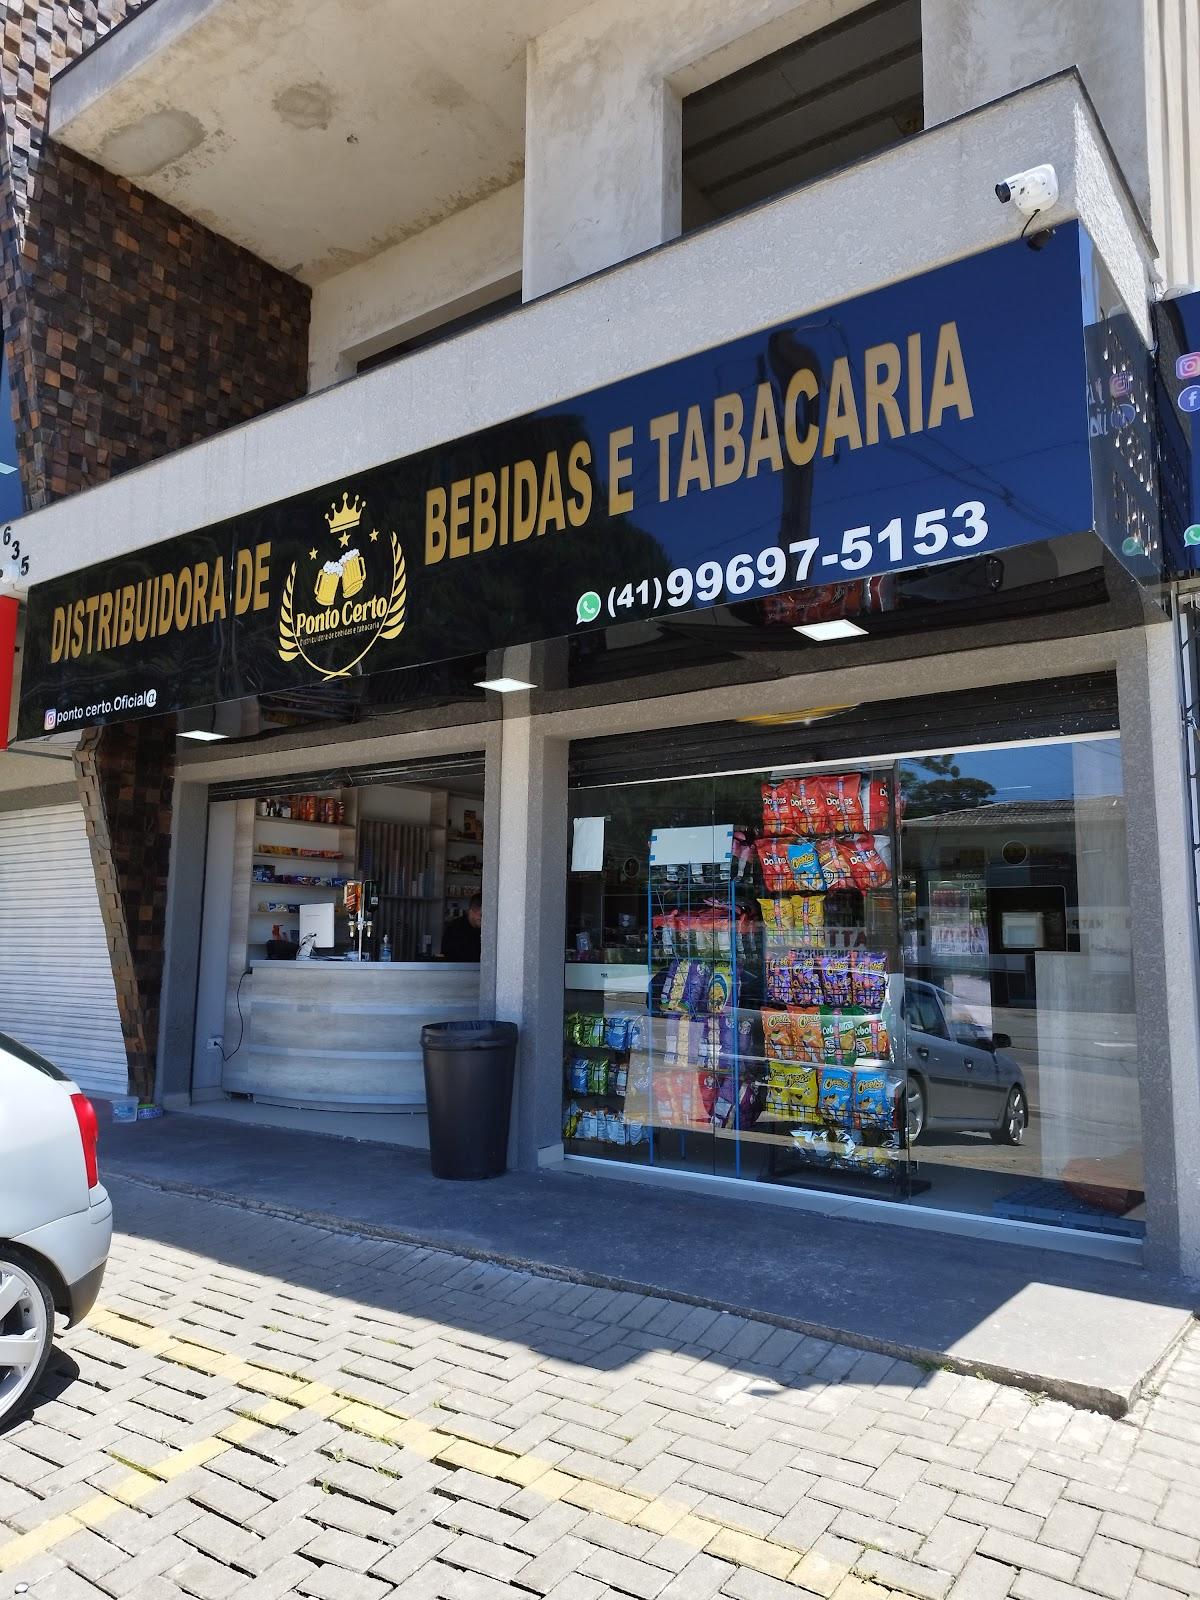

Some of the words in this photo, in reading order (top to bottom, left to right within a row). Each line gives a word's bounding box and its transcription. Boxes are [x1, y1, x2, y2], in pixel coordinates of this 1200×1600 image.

[50, 556, 226, 664] DISTRIBUIDORA
[234, 542, 272, 616] DE
[424, 440, 593, 566] BEBIDAS
[608, 426, 634, 517] E
[649, 320, 975, 503] TABACARIA
[296, 606, 340, 638] Ponto
[341, 595, 388, 626] Certo
[57, 706, 83, 726] ponto
